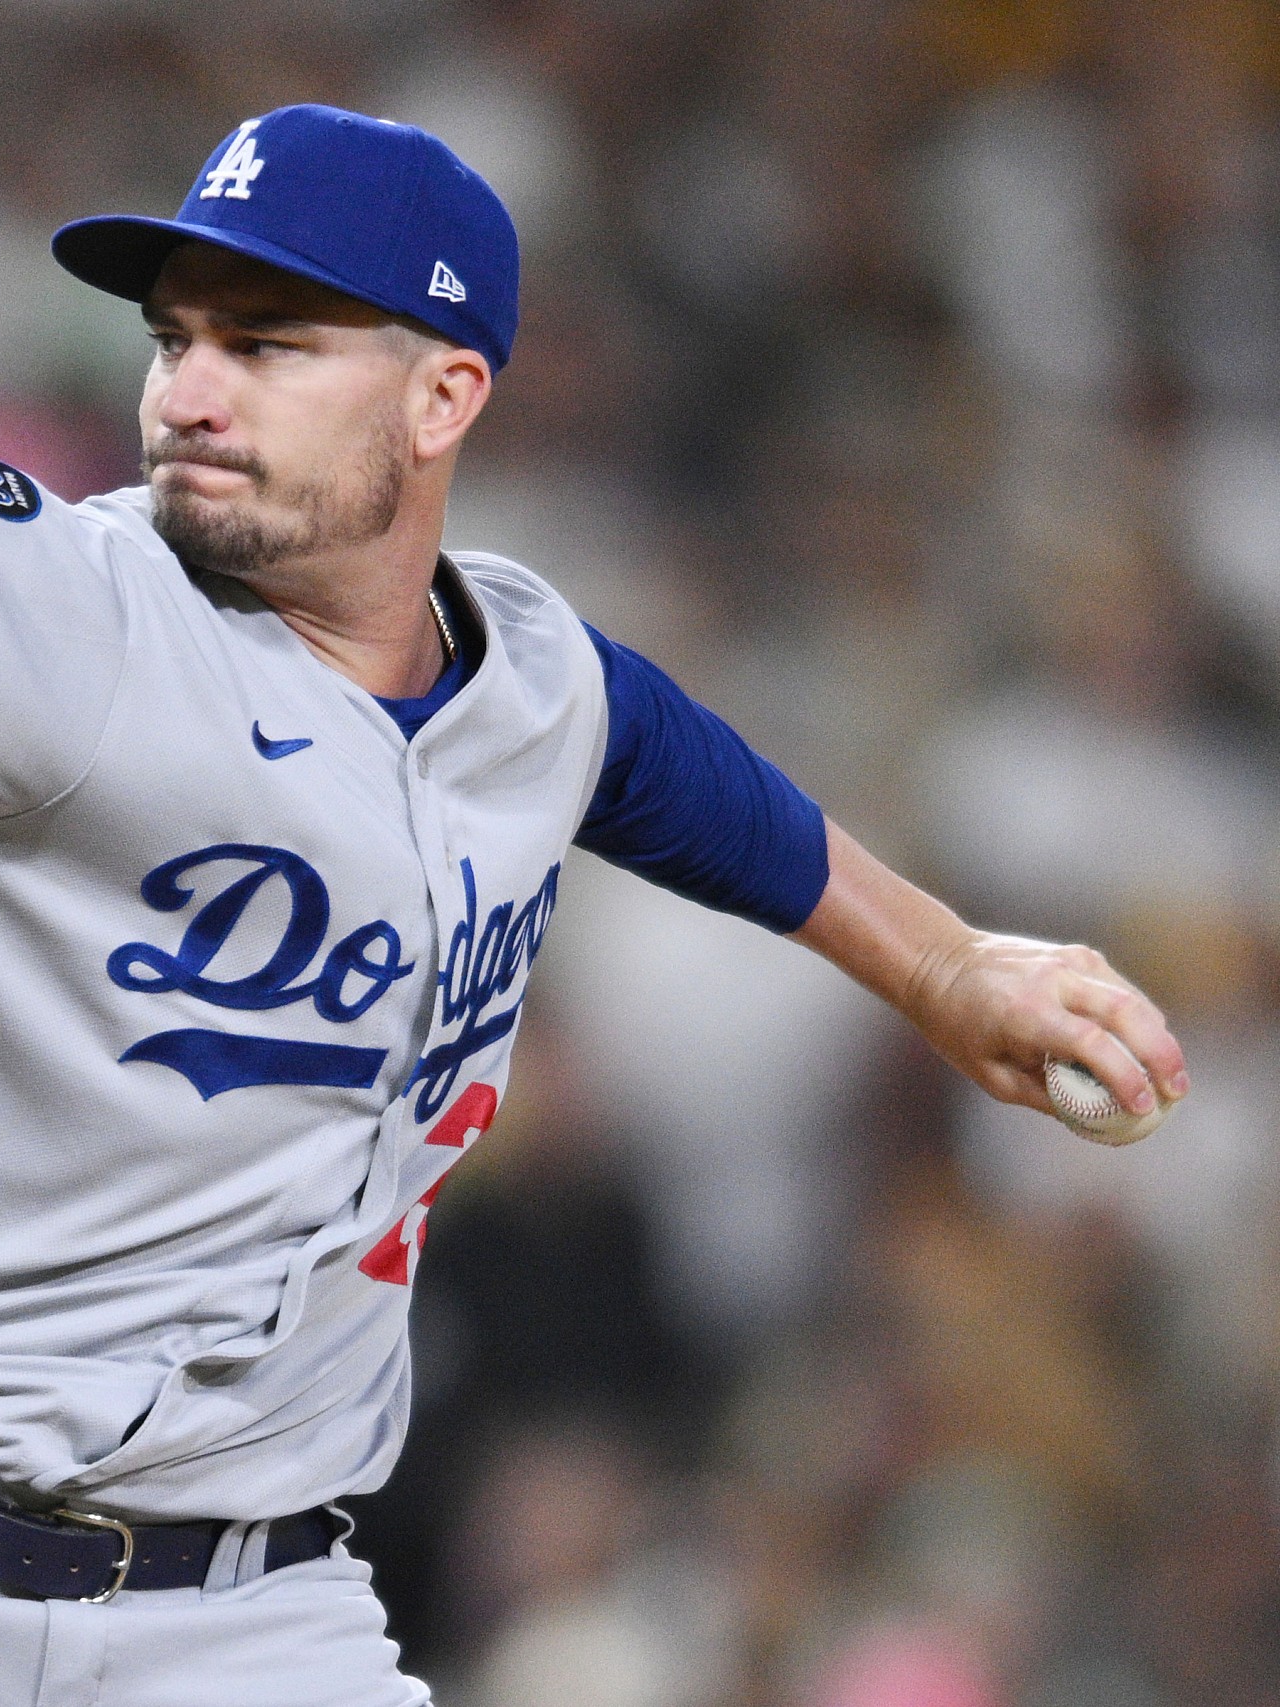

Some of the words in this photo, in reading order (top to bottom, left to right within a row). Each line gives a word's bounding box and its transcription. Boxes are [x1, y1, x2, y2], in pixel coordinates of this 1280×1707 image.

[199, 119, 265, 200] LA
[3, 471, 29, 508] MAURY
[357, 1081, 498, 1287] 2
